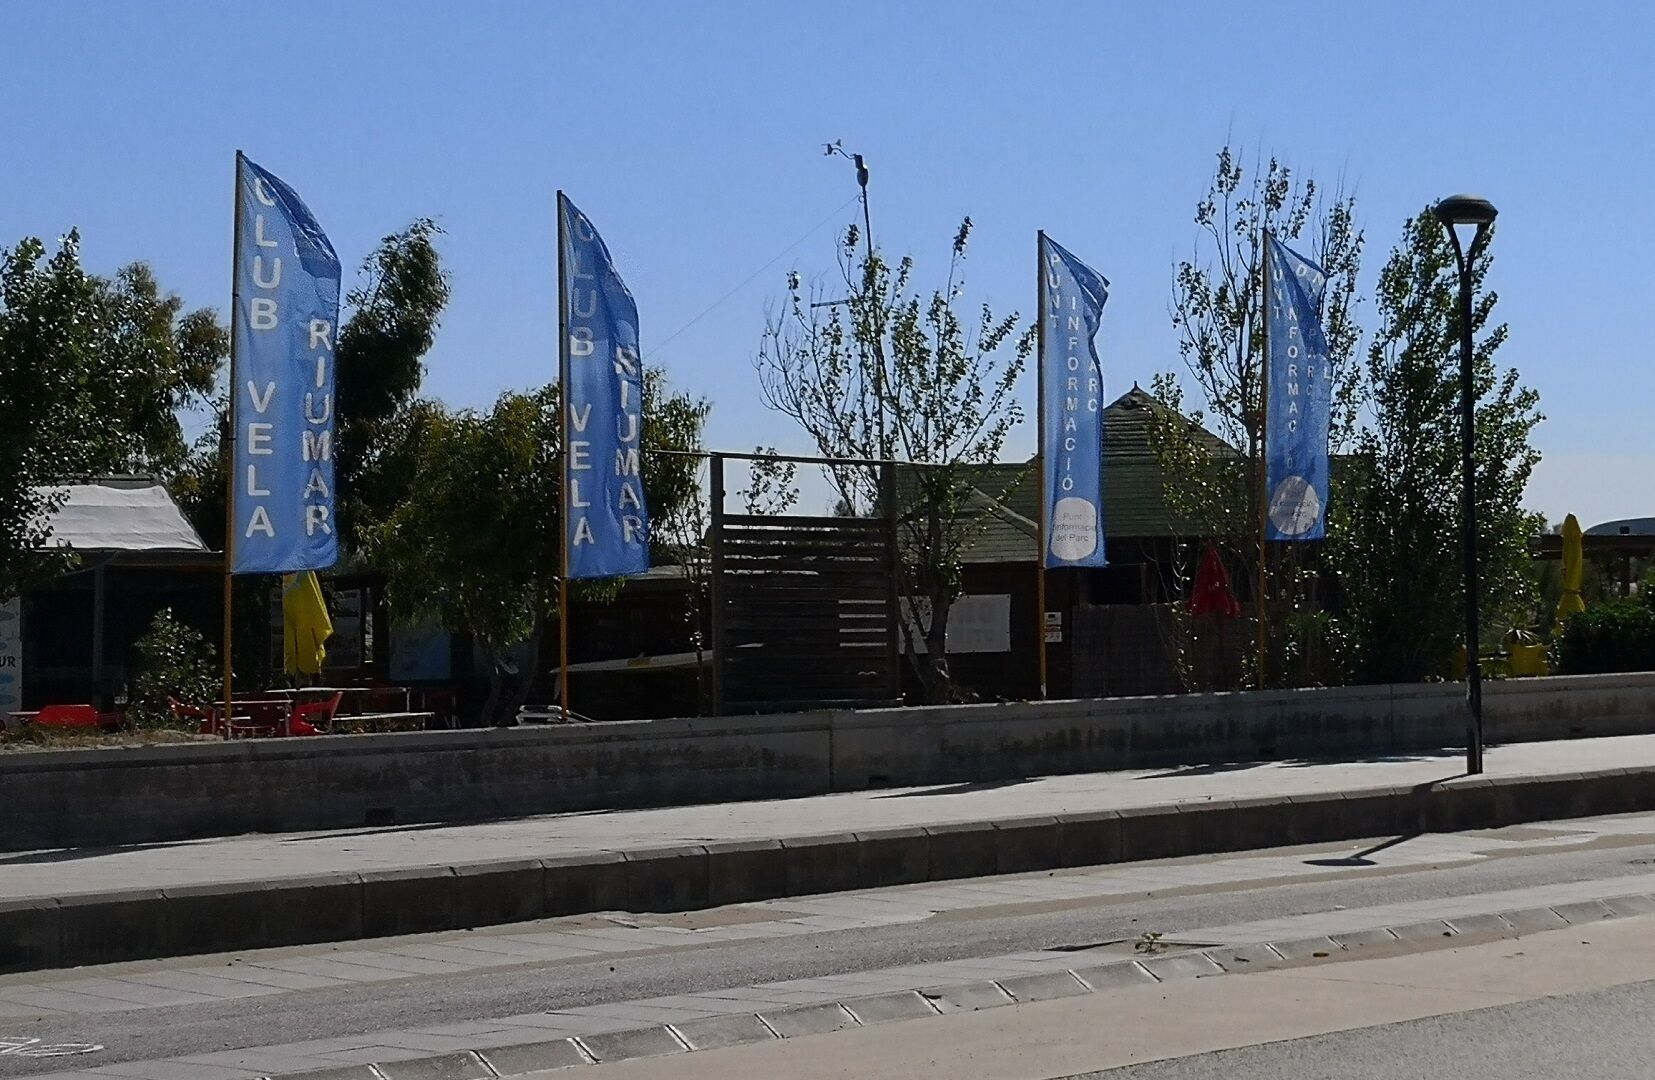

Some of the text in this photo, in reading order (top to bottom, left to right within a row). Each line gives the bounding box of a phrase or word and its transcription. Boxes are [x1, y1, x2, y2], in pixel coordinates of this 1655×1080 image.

[245, 178, 281, 538] CLUB VELA
[302, 318, 333, 536] RIUMAR
[569, 214, 597, 546] CLUB VELA
